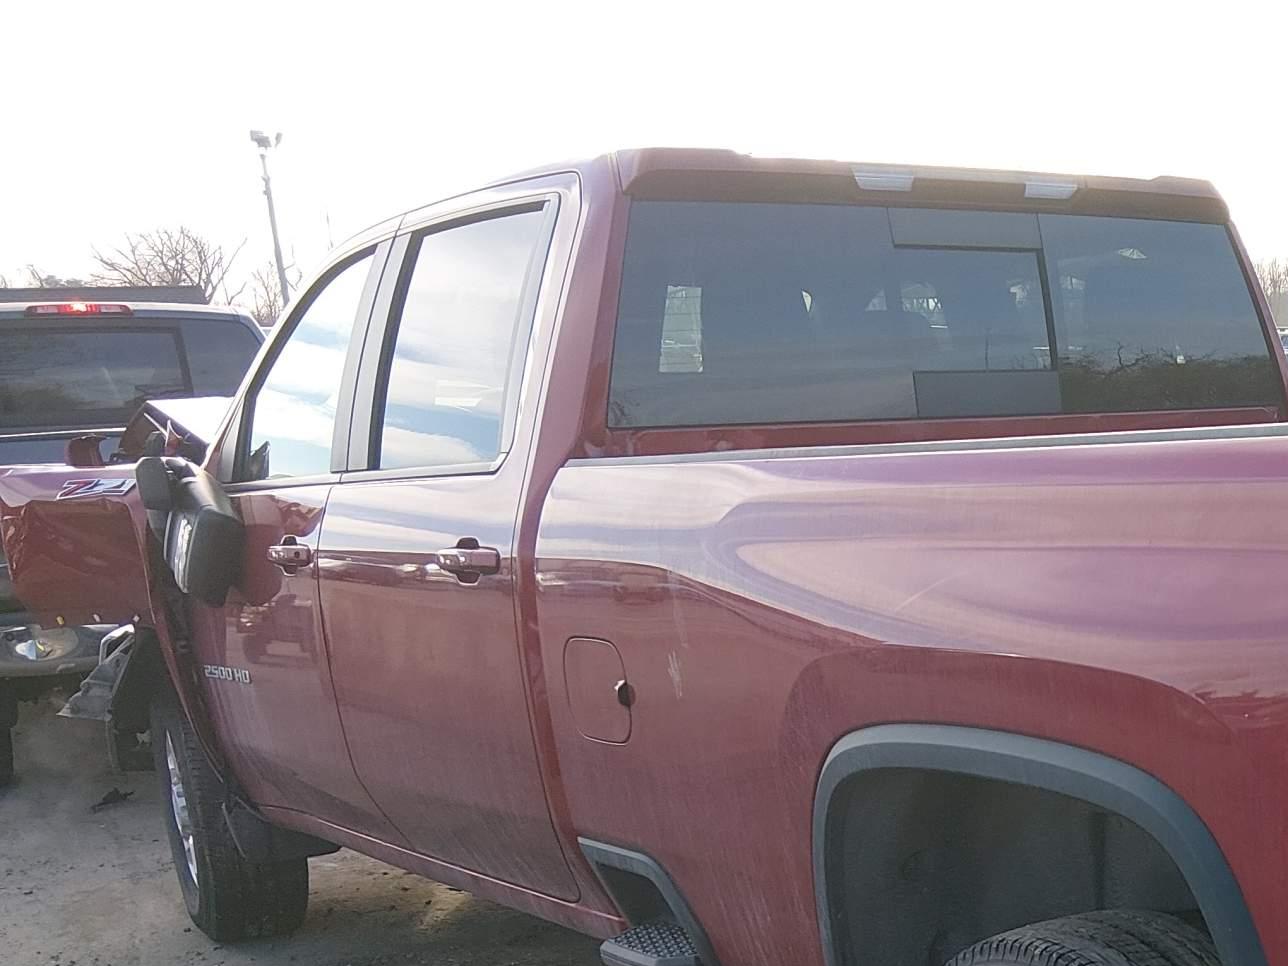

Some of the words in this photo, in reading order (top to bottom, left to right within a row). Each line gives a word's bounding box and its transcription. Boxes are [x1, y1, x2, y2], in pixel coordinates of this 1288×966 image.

[56, 479, 136, 500] Z71
[203, 664, 233, 680] 2500
[233, 668, 250, 683] HD
